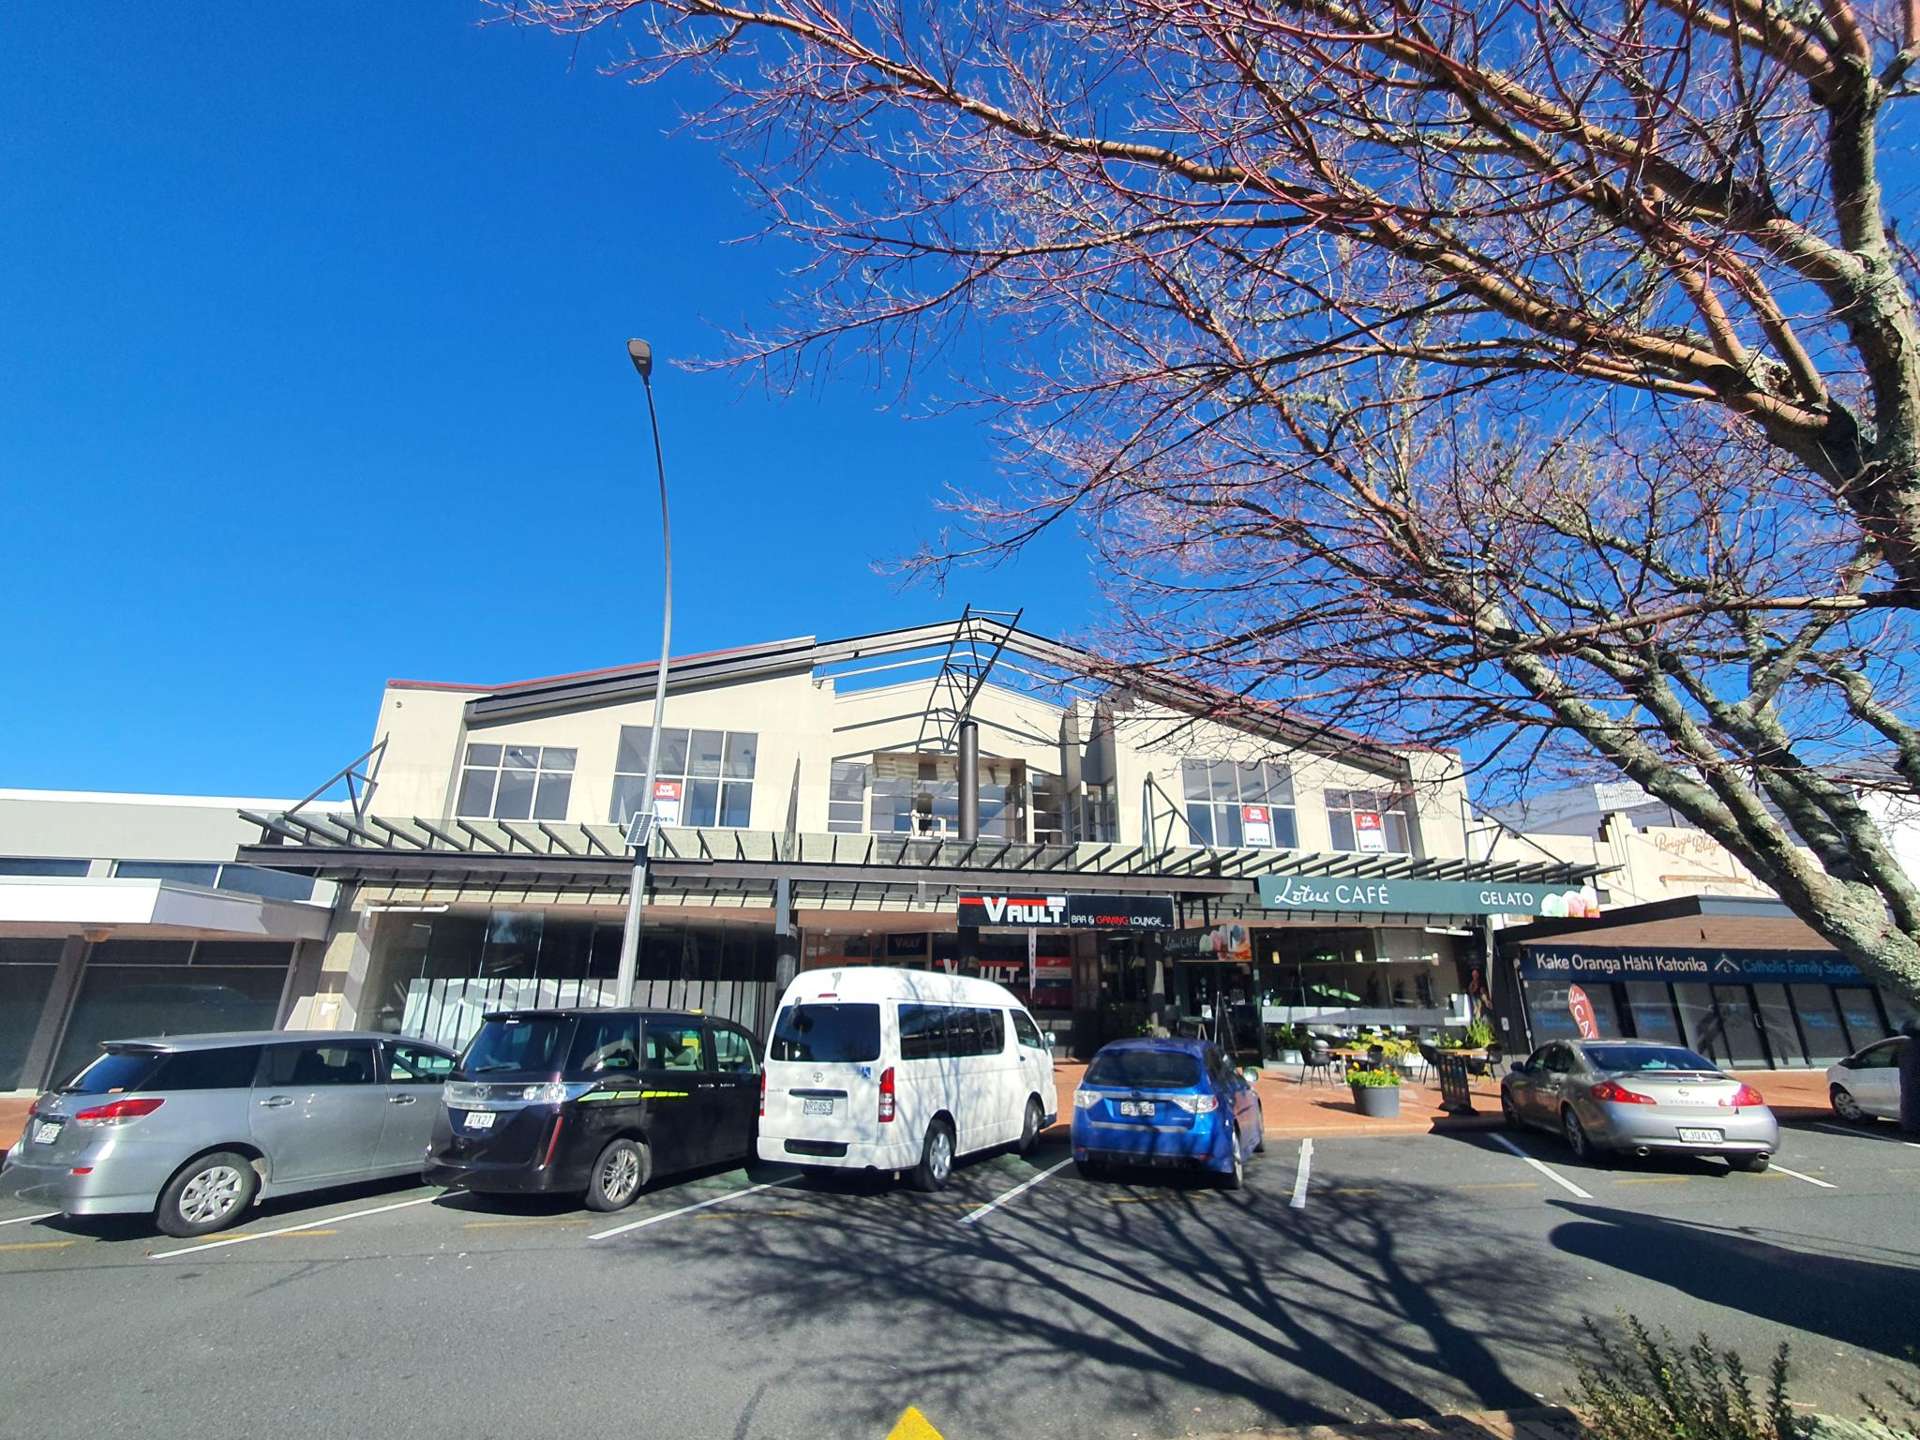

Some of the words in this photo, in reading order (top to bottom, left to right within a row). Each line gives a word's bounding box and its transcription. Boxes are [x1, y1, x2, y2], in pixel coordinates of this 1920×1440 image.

[1274, 877, 1330, 906] Lotus
[1335, 883, 1390, 905] CAFÉ
[1480, 891, 1534, 906] GELATO
[982, 896, 1067, 924] VAULT
[1071, 915, 1087, 924] BAR
[1088, 915, 1095, 925] &
[1096, 916, 1129, 926] GAMING
[1130, 916, 1161, 927] LOUNGE
[1535, 952, 1570, 970] Kake
[1571, 953, 1621, 974] Oranga
[1622, 954, 1654, 971] Hāhi
[1655, 955, 1708, 972] Katorika
[1742, 959, 1787, 974] Catholic
[1787, 959, 1823, 977] Family
[1823, 959, 1860, 977] Suppo
